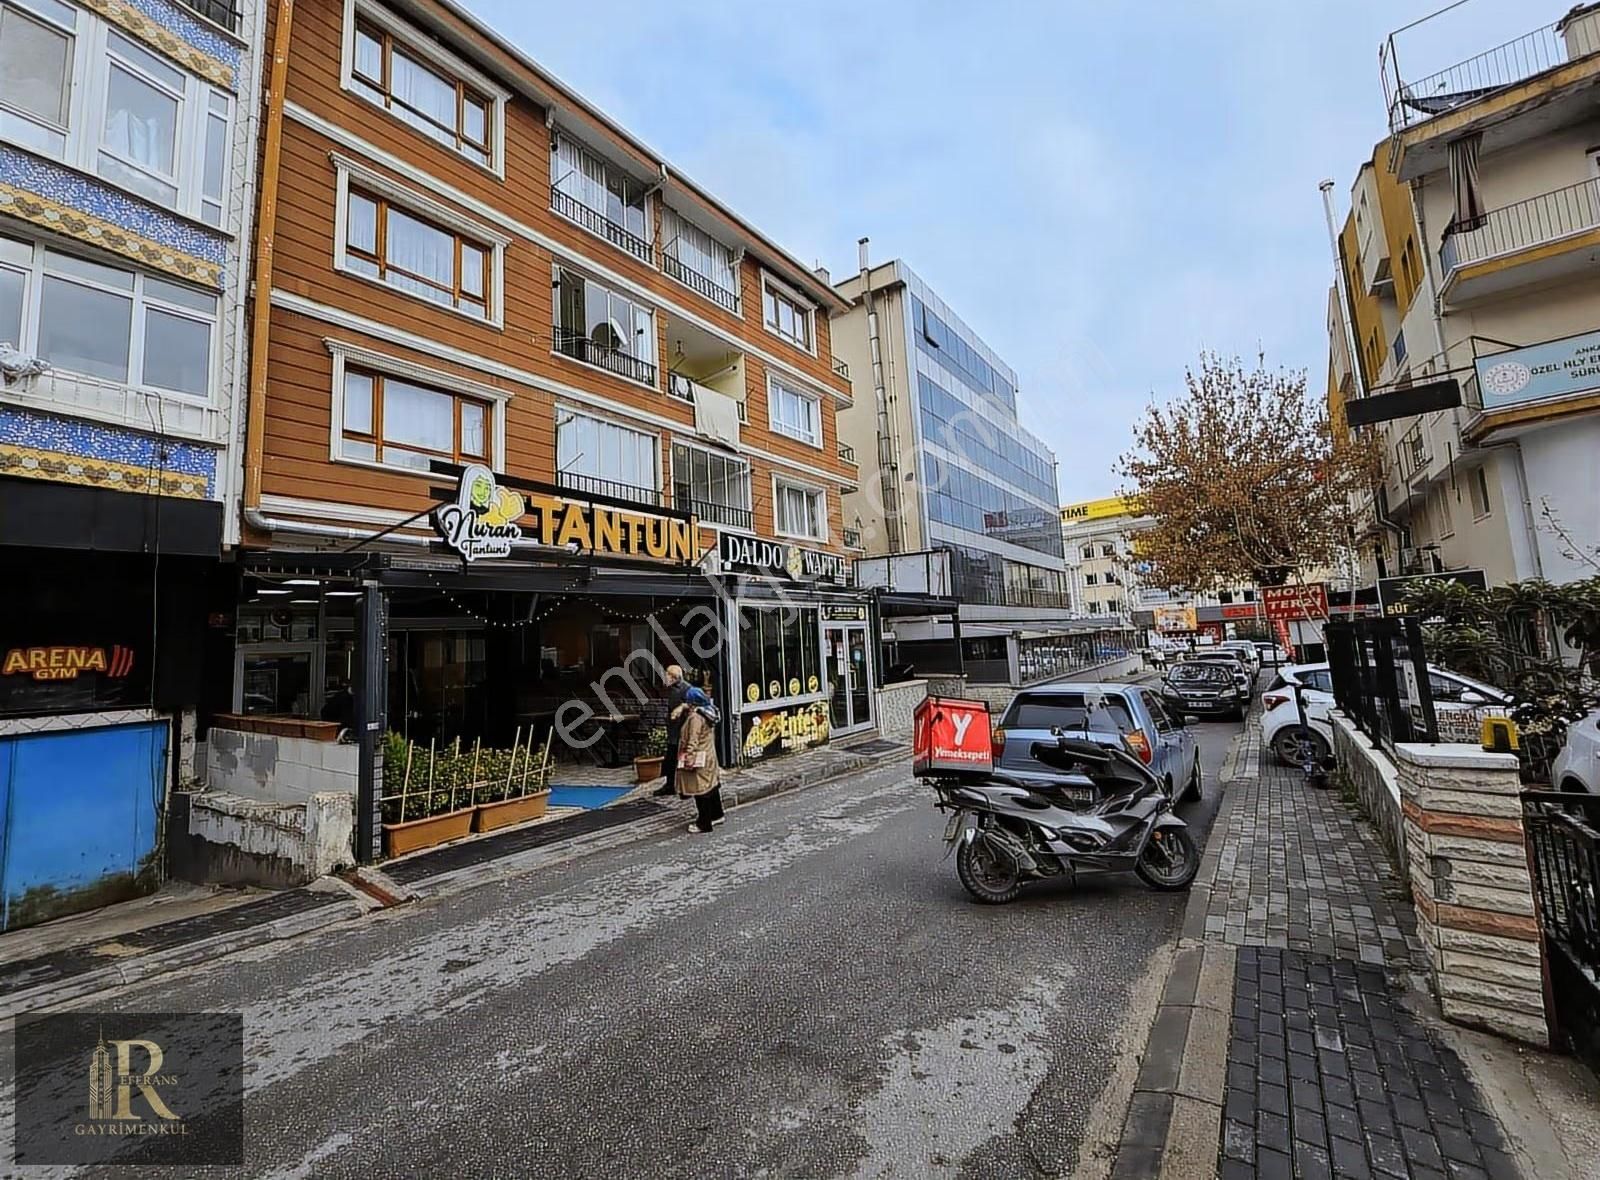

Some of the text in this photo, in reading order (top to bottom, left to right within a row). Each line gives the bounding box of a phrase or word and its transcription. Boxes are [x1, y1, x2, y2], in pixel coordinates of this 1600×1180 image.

[442, 508, 519, 543] Nuran
[461, 540, 507, 558] Tantuni
[728, 536, 783, 569] DALDO
[6, 648, 105, 672] ARENA
[36, 668, 78, 679] GYM
[951, 712, 973, 746] Y
